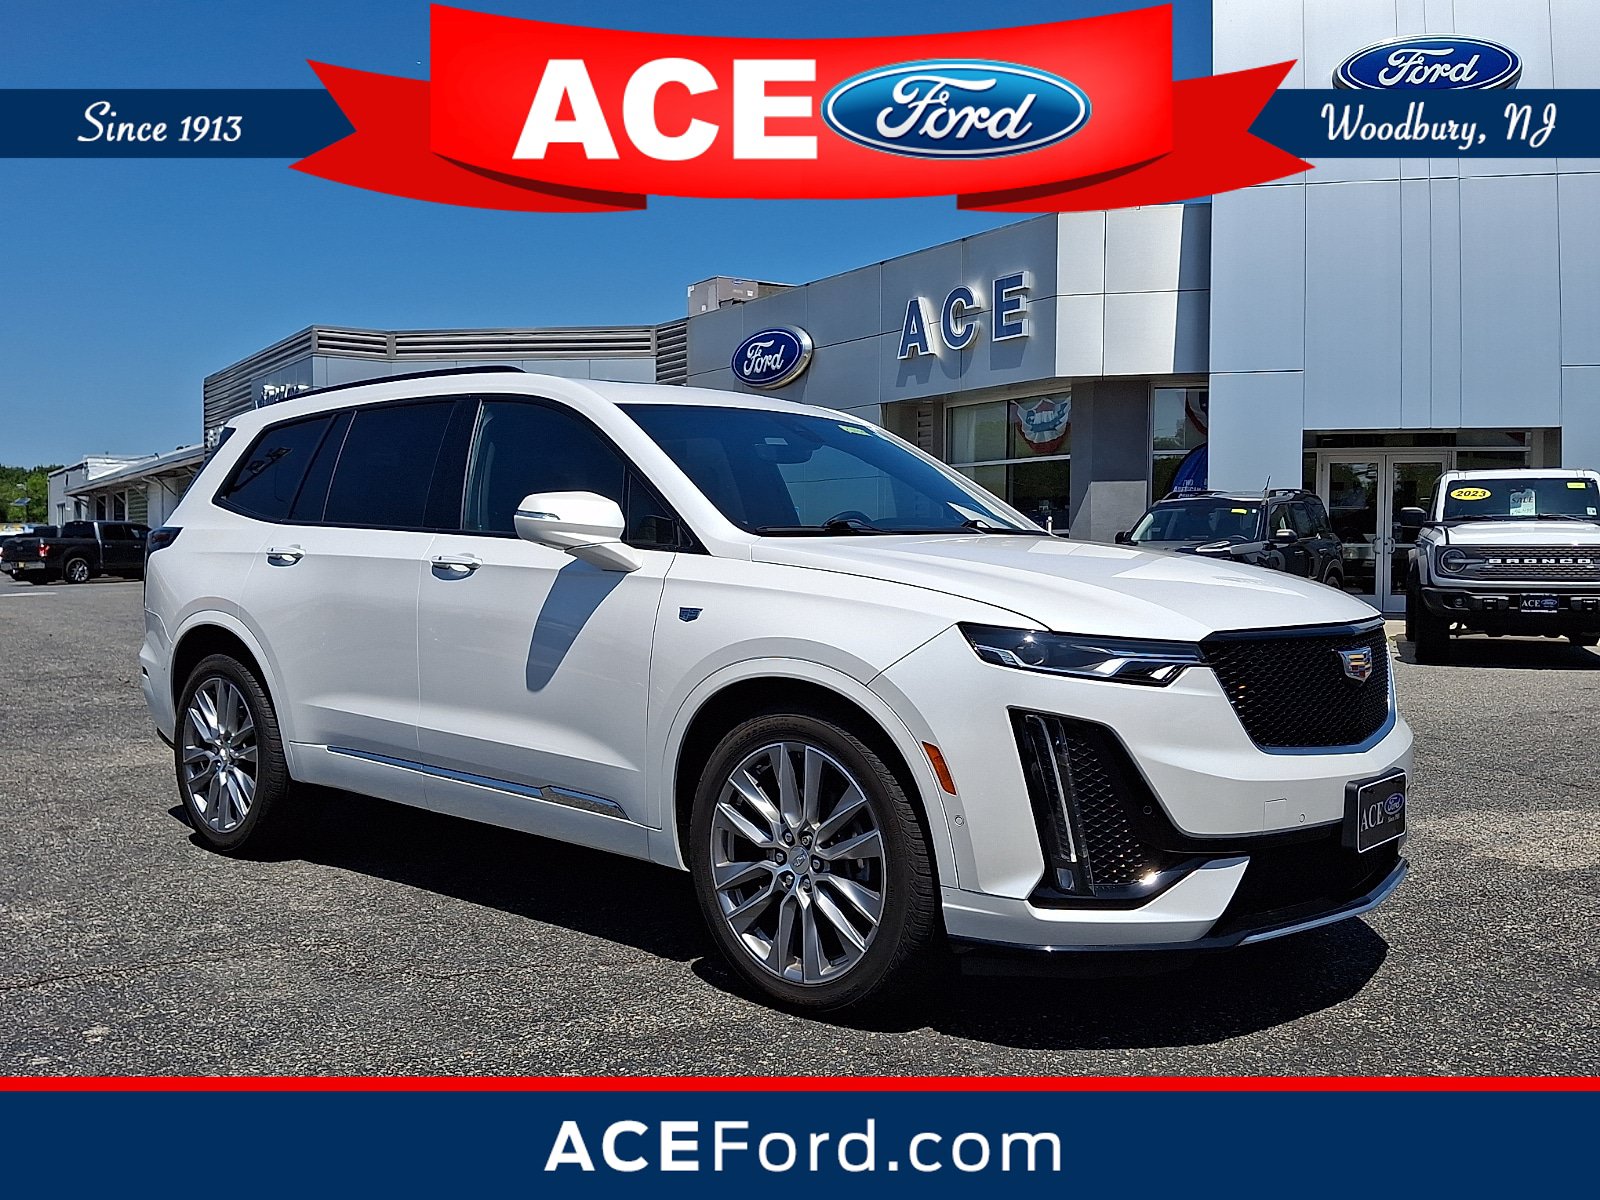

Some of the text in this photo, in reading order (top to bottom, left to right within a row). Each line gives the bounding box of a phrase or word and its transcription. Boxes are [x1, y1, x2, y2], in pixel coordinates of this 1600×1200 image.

[1378, 48, 1481, 86] Ford
[897, 270, 1030, 360] ACE
[743, 338, 785, 376] Ford
[1521, 599, 1541, 607] ACE
[1360, 801, 1384, 832] ACE
